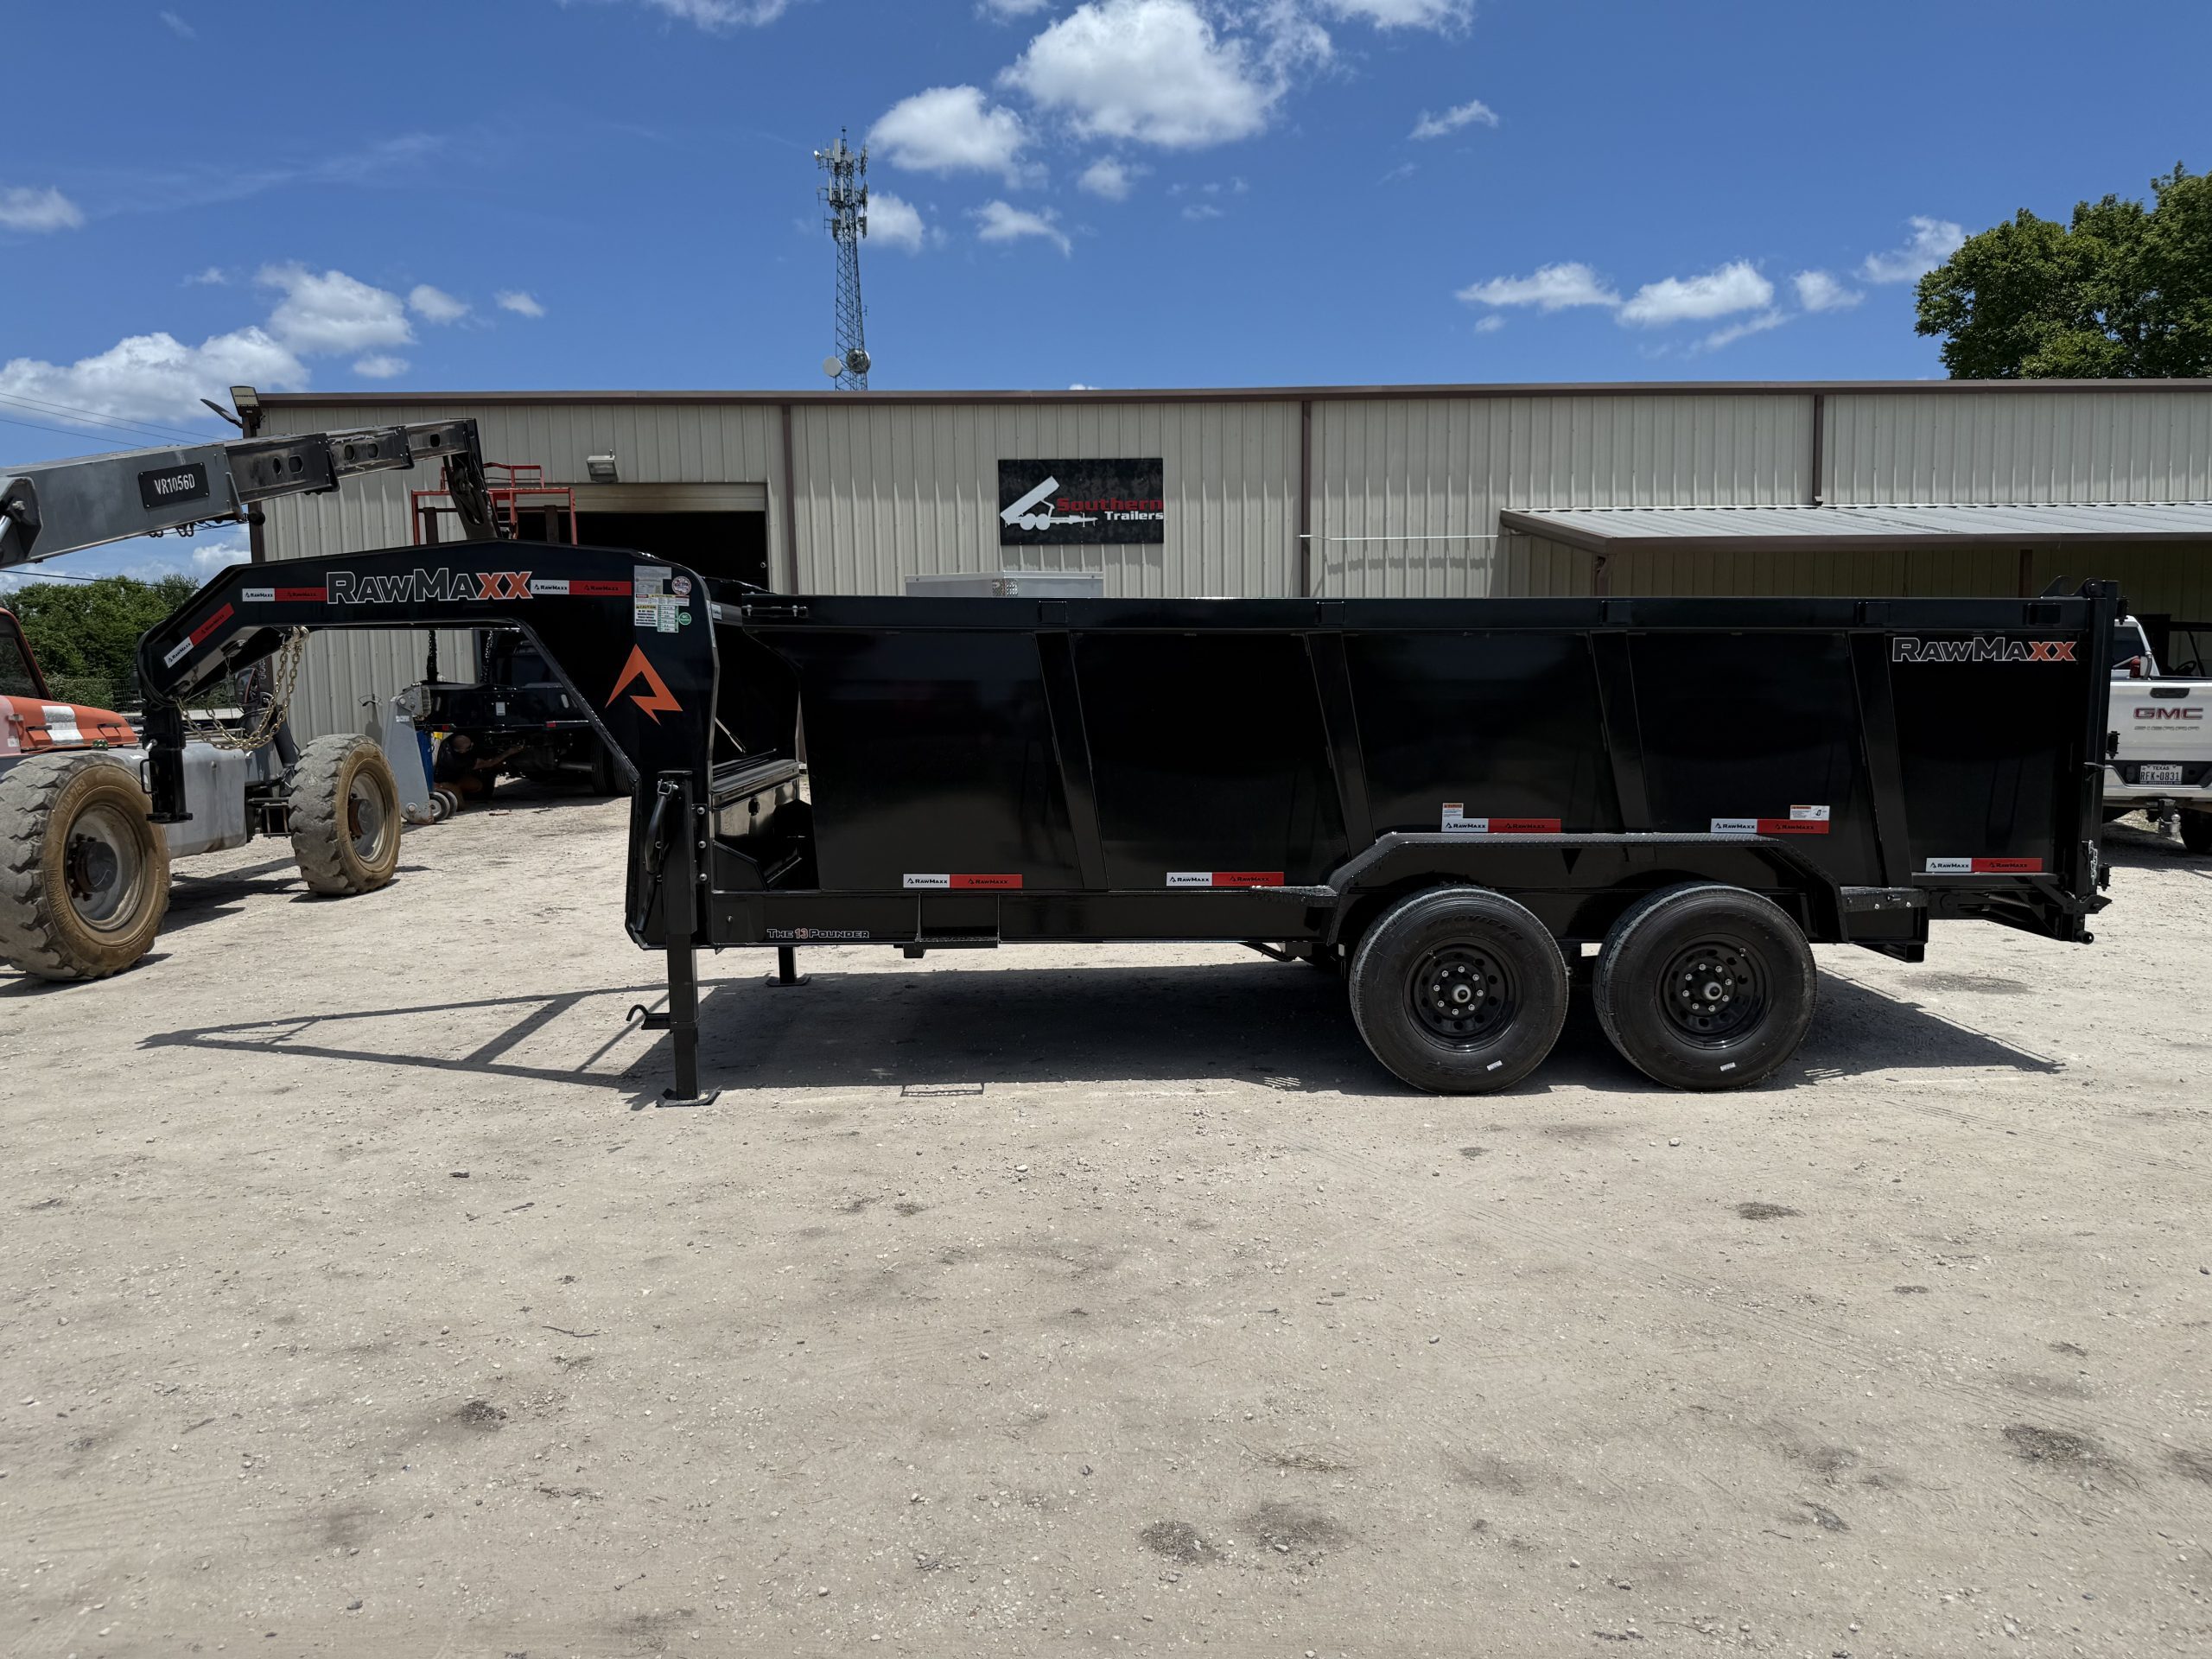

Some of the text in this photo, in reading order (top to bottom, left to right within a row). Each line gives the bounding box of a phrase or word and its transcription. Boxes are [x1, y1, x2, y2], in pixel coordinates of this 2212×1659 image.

[154, 474, 195, 495] VR1056D
[1056, 498, 1164, 512] Southern
[1104, 511, 1164, 520] Trailers
[2133, 708, 2203, 720] GMC
[795, 928, 807, 938] 13
